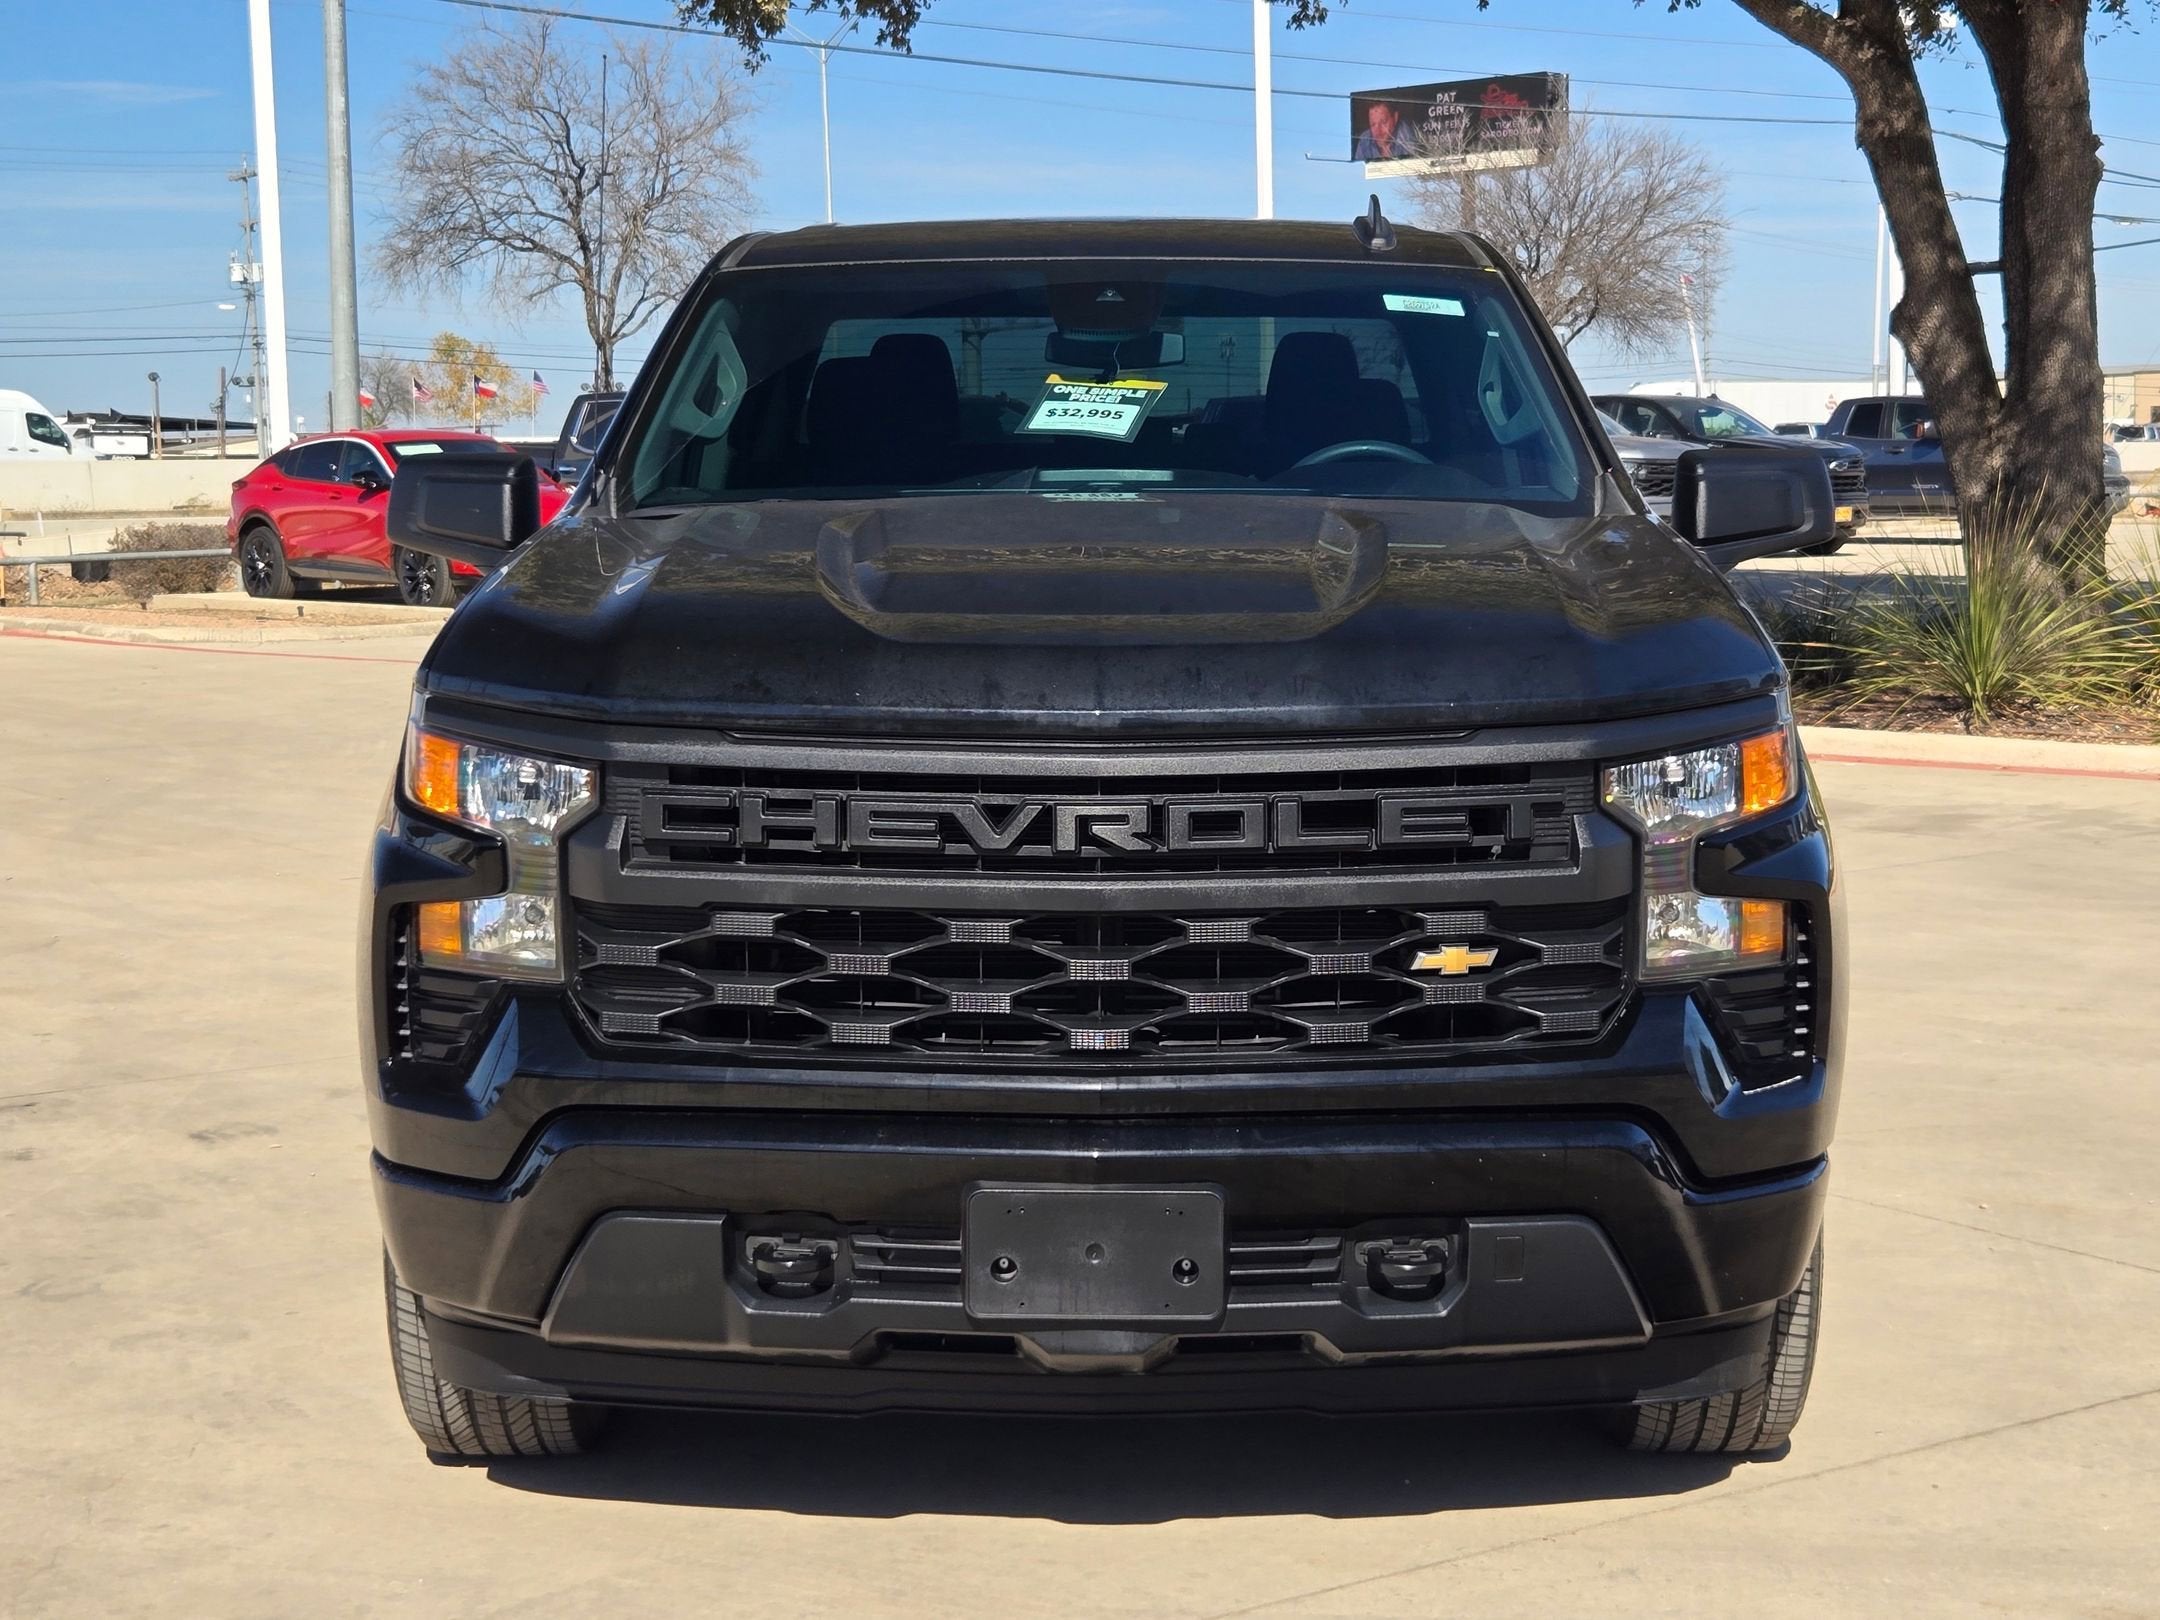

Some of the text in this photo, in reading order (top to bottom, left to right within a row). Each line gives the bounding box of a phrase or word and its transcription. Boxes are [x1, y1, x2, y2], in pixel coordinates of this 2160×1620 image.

[1436, 92, 1457, 104] PAT
[1428, 105, 1465, 118] GREEN
[1422, 120, 1441, 132] SUN
[1053, 385, 1148, 398] ONE SIMPLE
[1068, 393, 1123, 404] PRICE!
[1044, 407, 1125, 420] $32,995
[642, 786, 1566, 857] CHEVROLET
